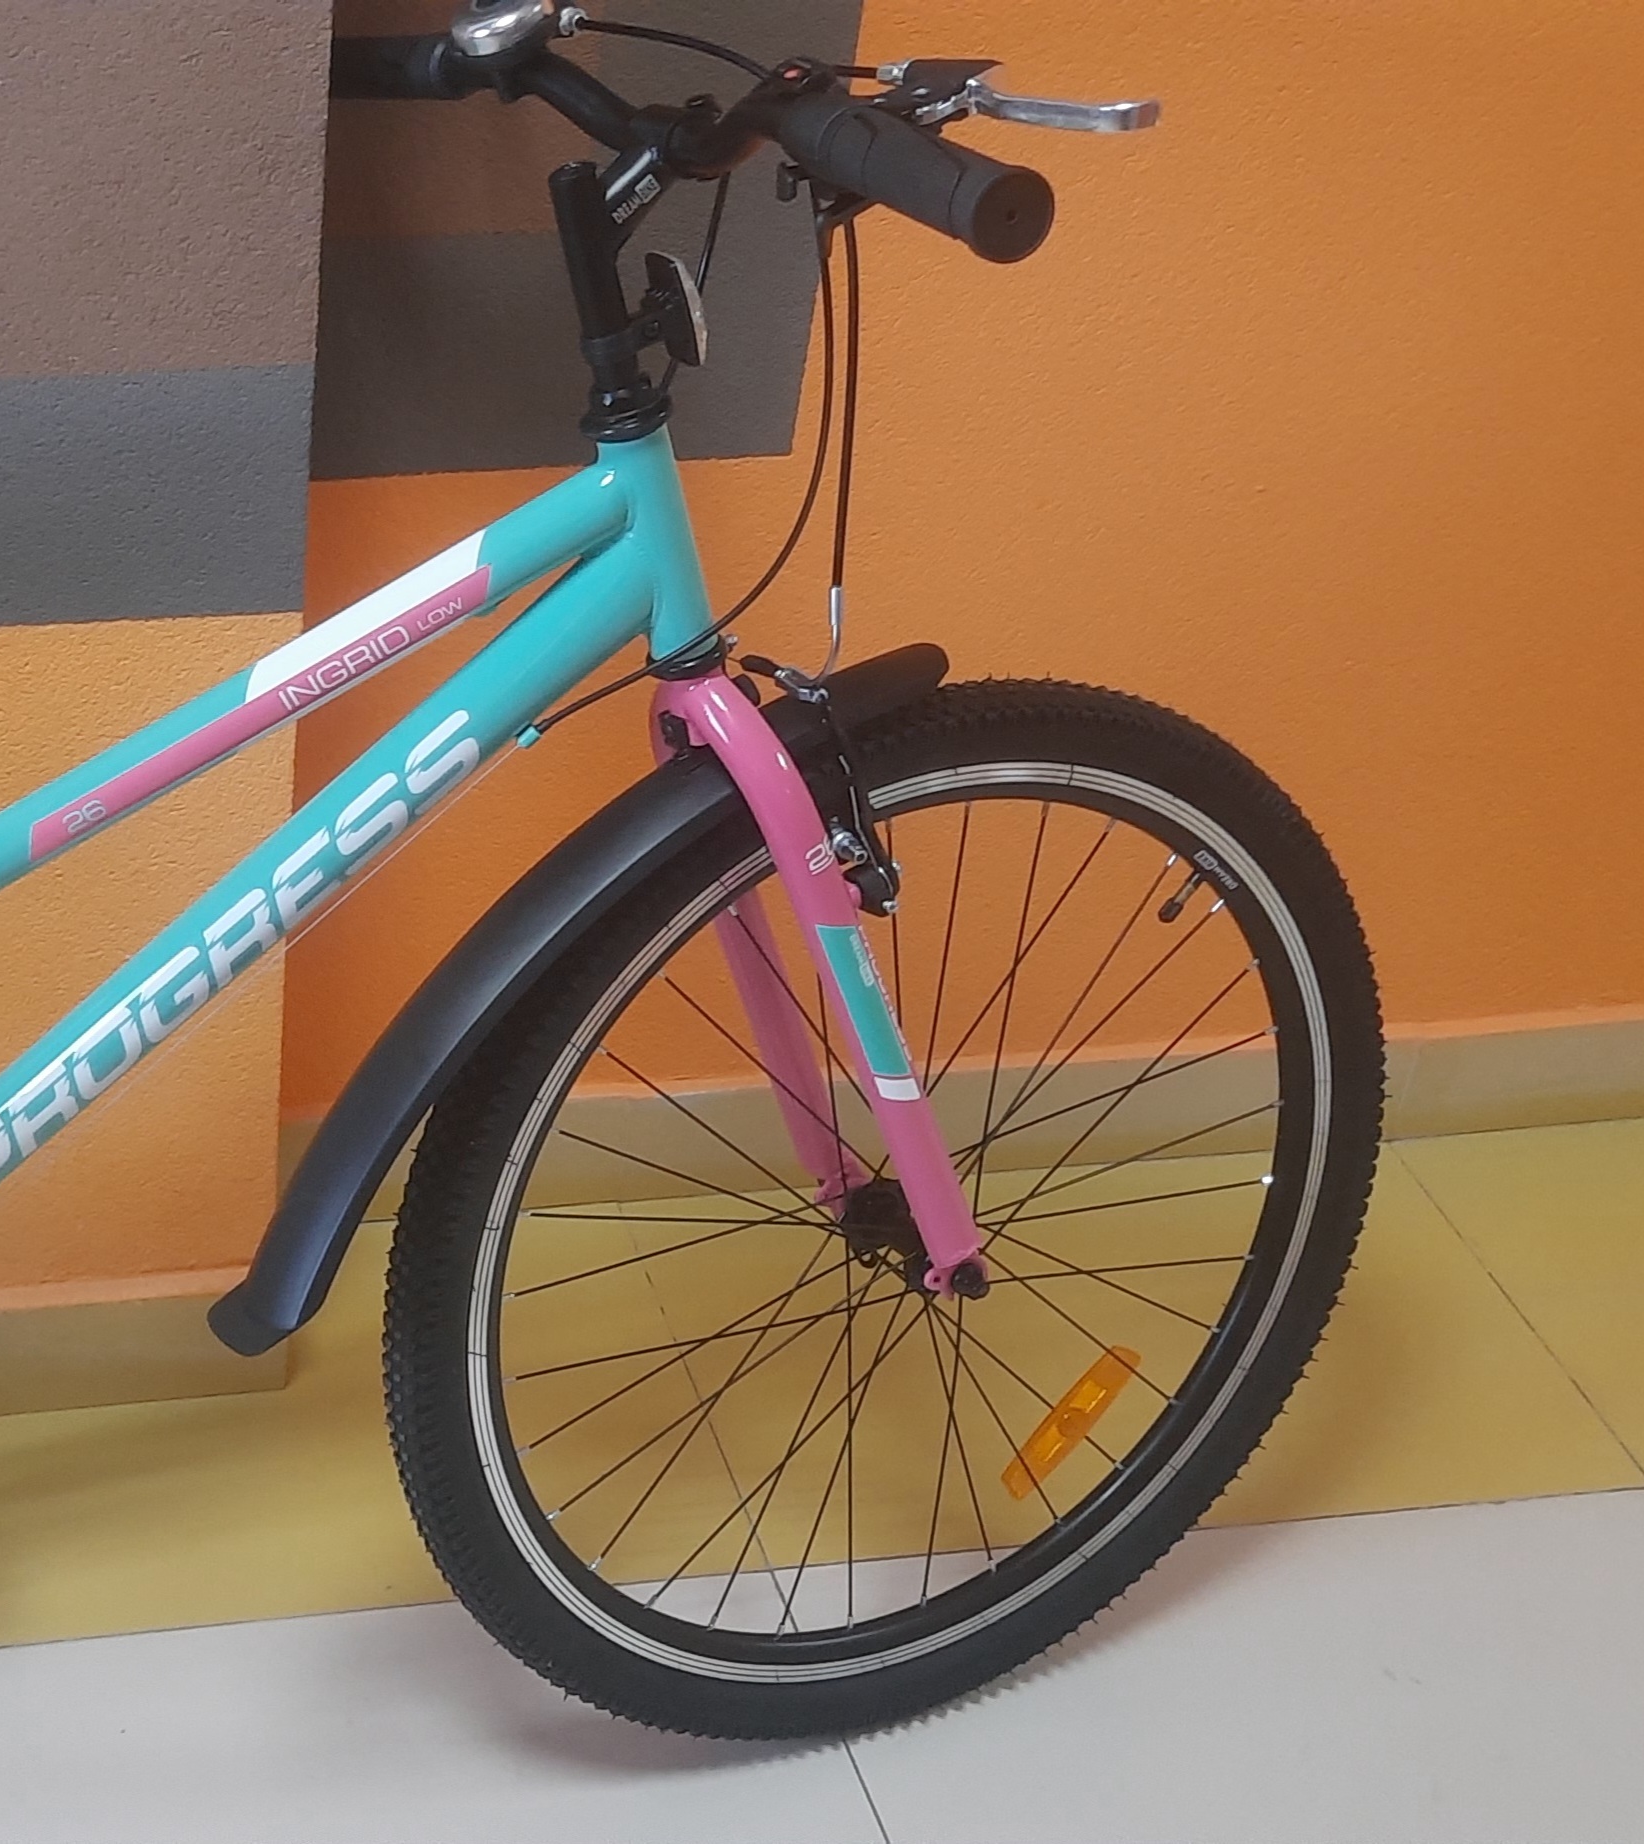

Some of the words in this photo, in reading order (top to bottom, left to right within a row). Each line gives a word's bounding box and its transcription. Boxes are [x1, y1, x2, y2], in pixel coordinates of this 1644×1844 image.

[611, 193, 643, 225] DREAM
[278, 623, 413, 711] INGRID
[416, 596, 464, 632] LOW
[61, 799, 107, 834] 26
